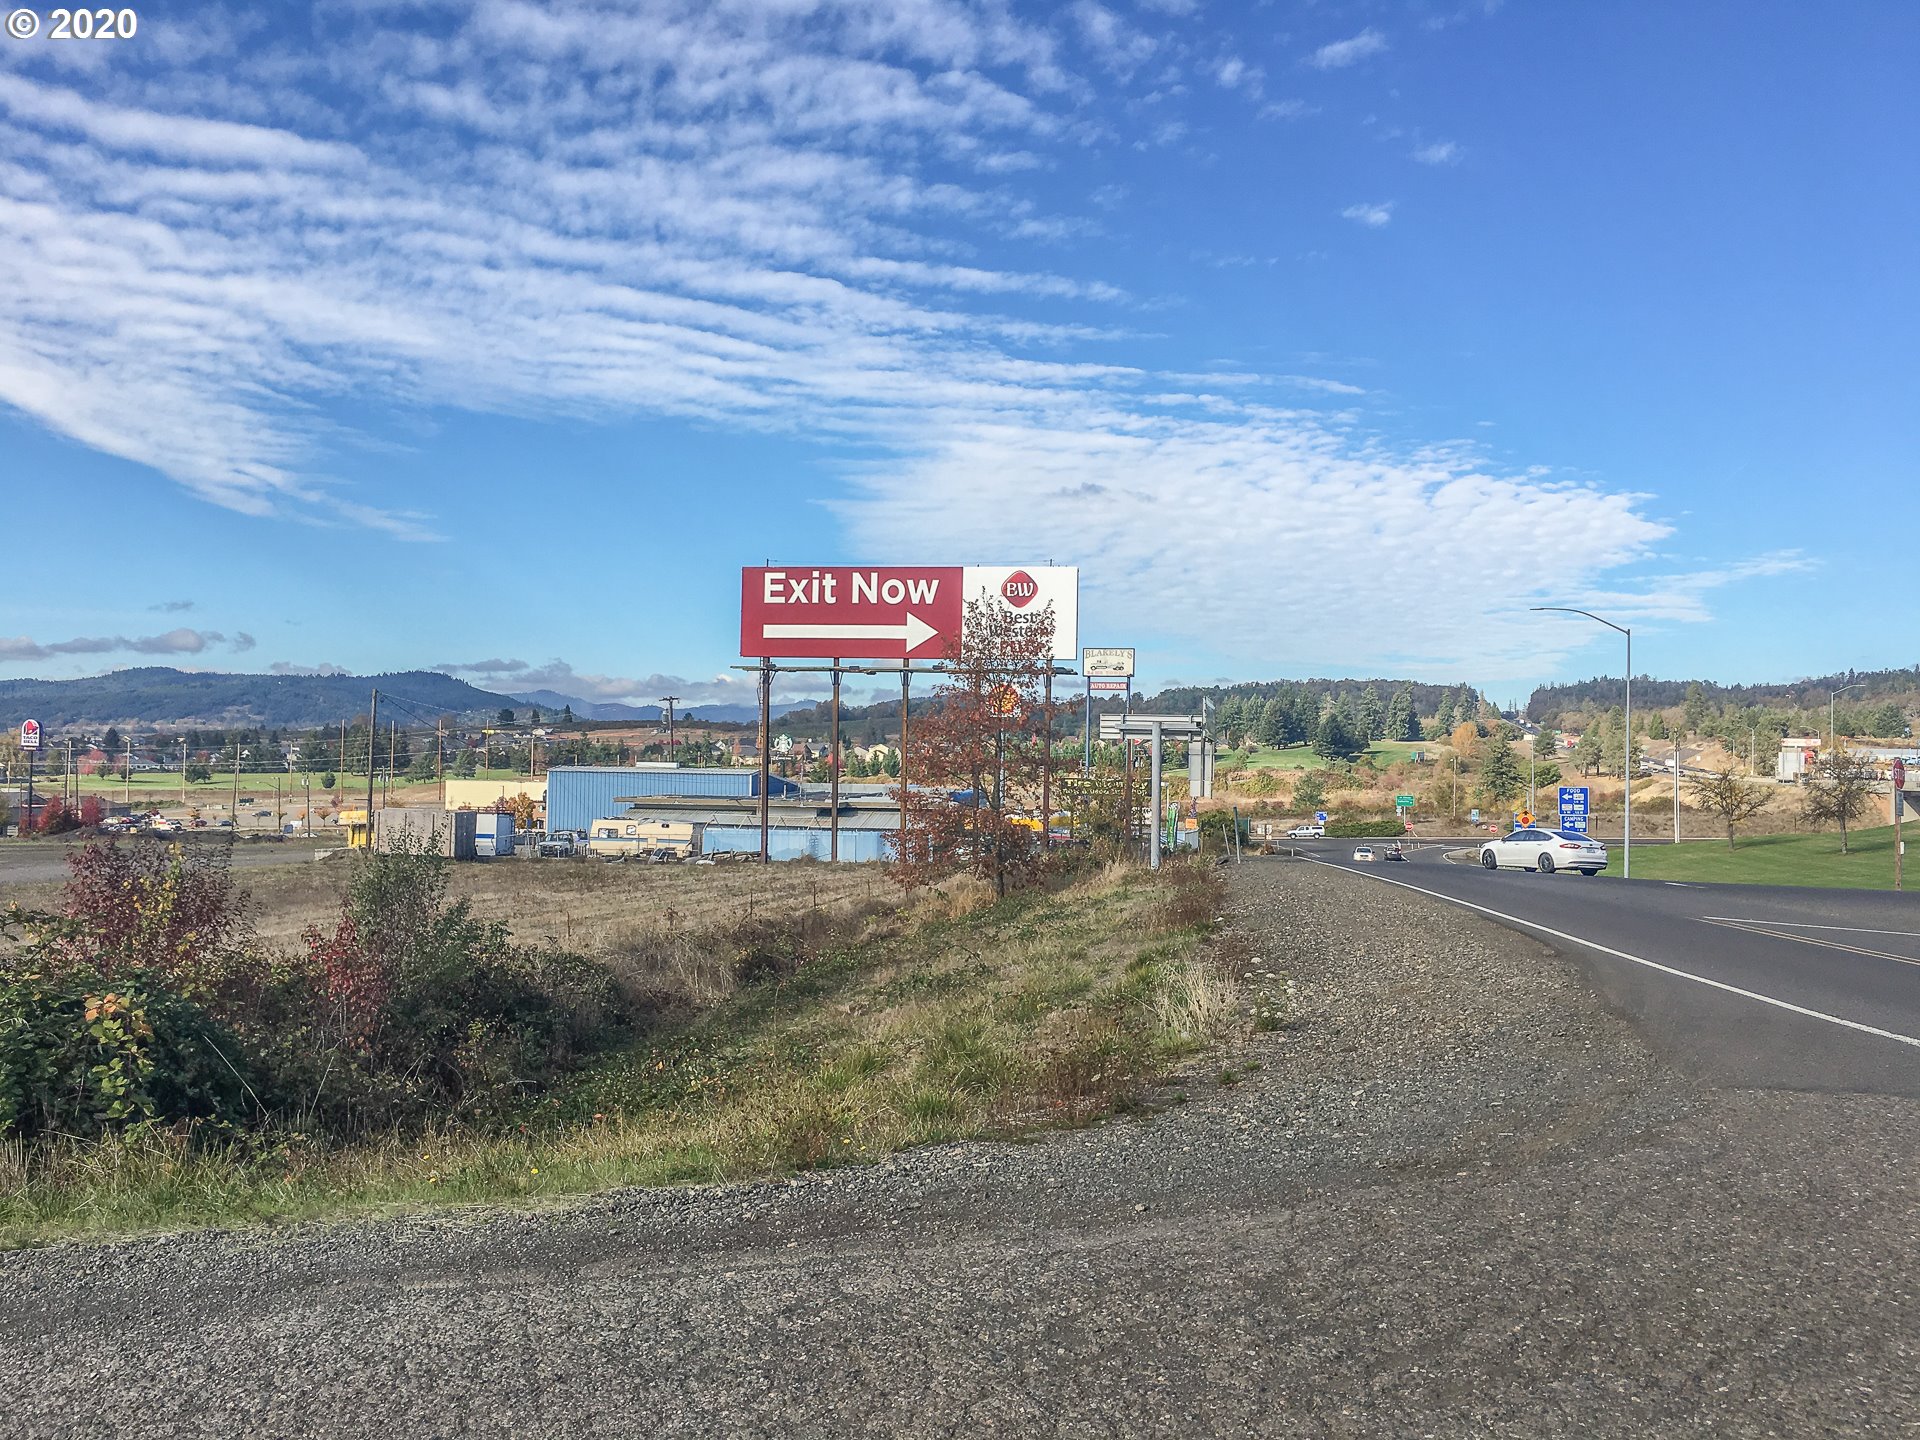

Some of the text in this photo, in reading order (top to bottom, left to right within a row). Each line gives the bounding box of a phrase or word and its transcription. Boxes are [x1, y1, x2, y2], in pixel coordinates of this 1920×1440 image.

[763, 571, 940, 605] Exit Now
[1006, 582, 1033, 597] BW
[1004, 611, 1037, 624] Best
